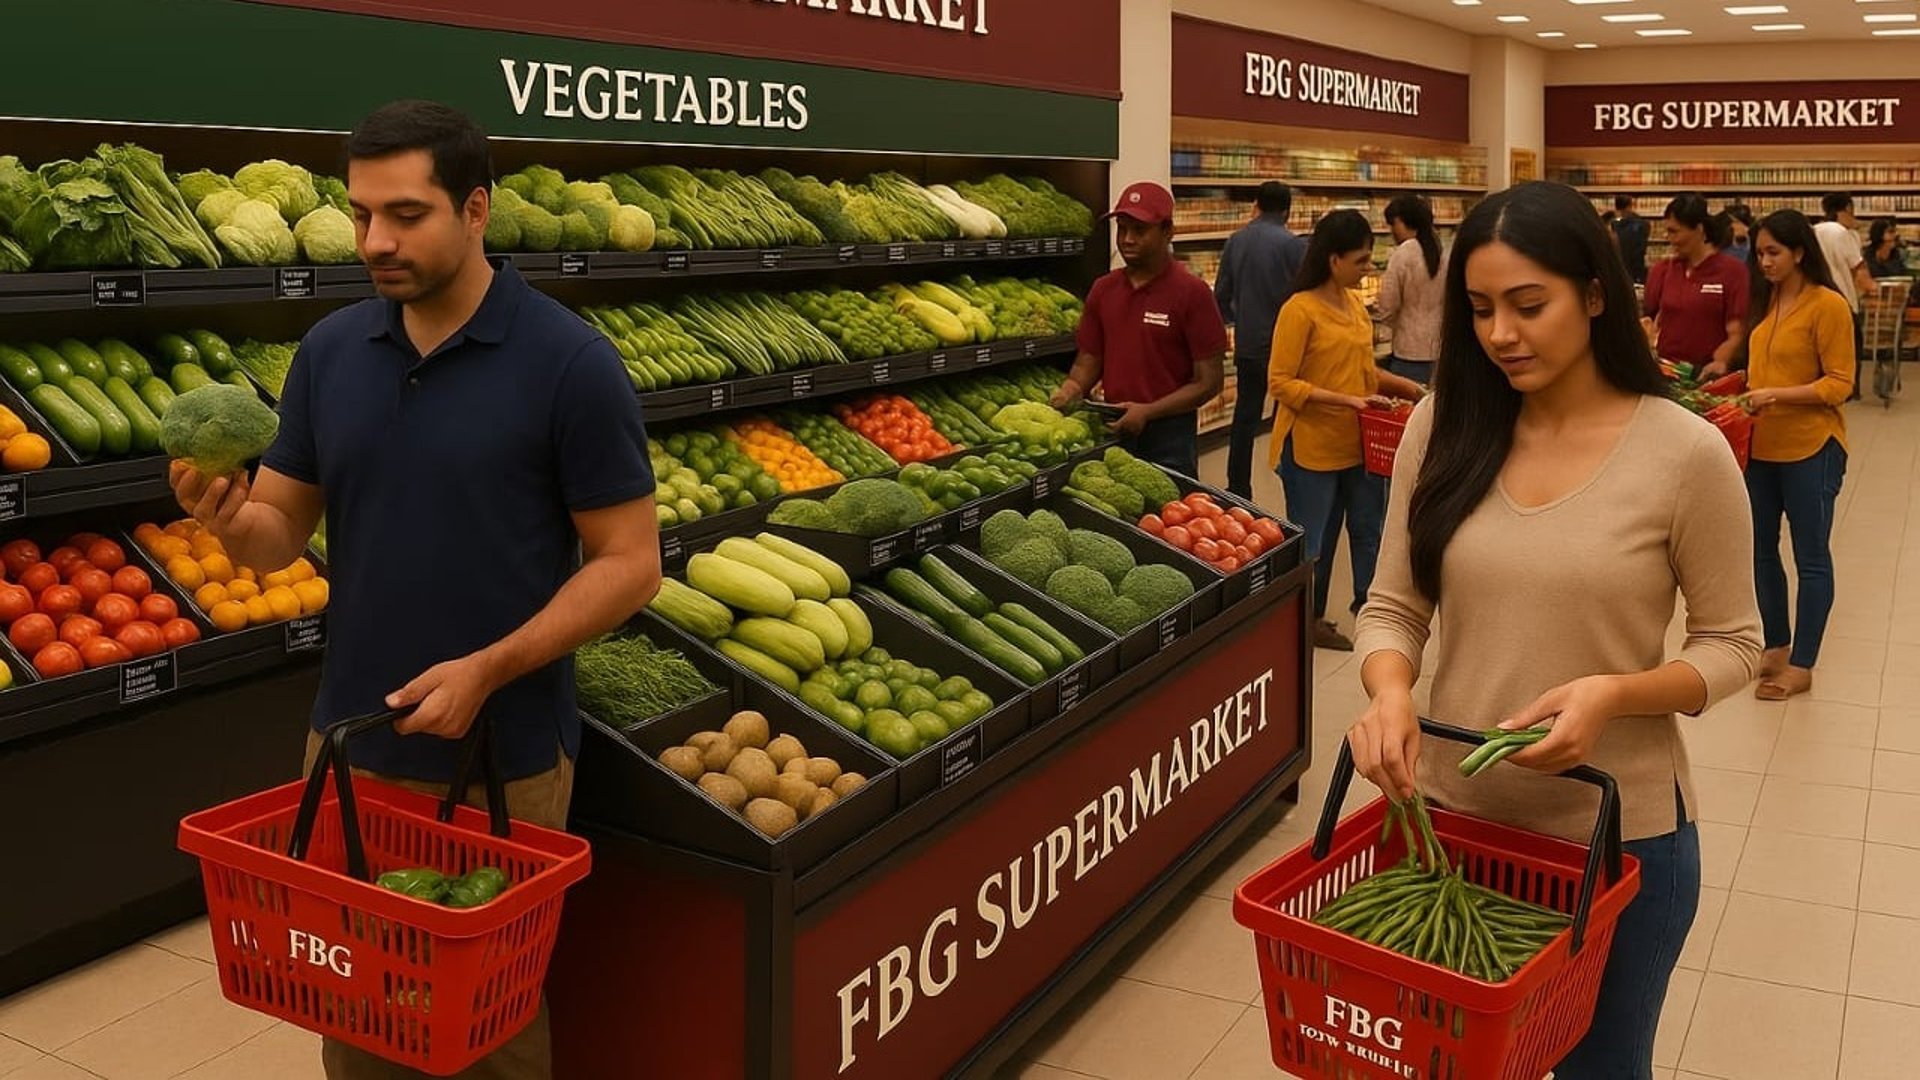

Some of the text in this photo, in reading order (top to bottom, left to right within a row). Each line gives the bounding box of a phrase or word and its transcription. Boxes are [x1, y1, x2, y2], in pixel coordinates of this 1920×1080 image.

[500, 58, 808, 130] VEGETABLES
[1245, 52, 1421, 115] FBG SUPERMARKET
[1594, 98, 1900, 130] FBG SUPERMARKET
[837, 668, 1273, 1074] FBG SUPERMARKET
[288, 928, 352, 978] FBG
[1324, 995, 1403, 1051] FBG
